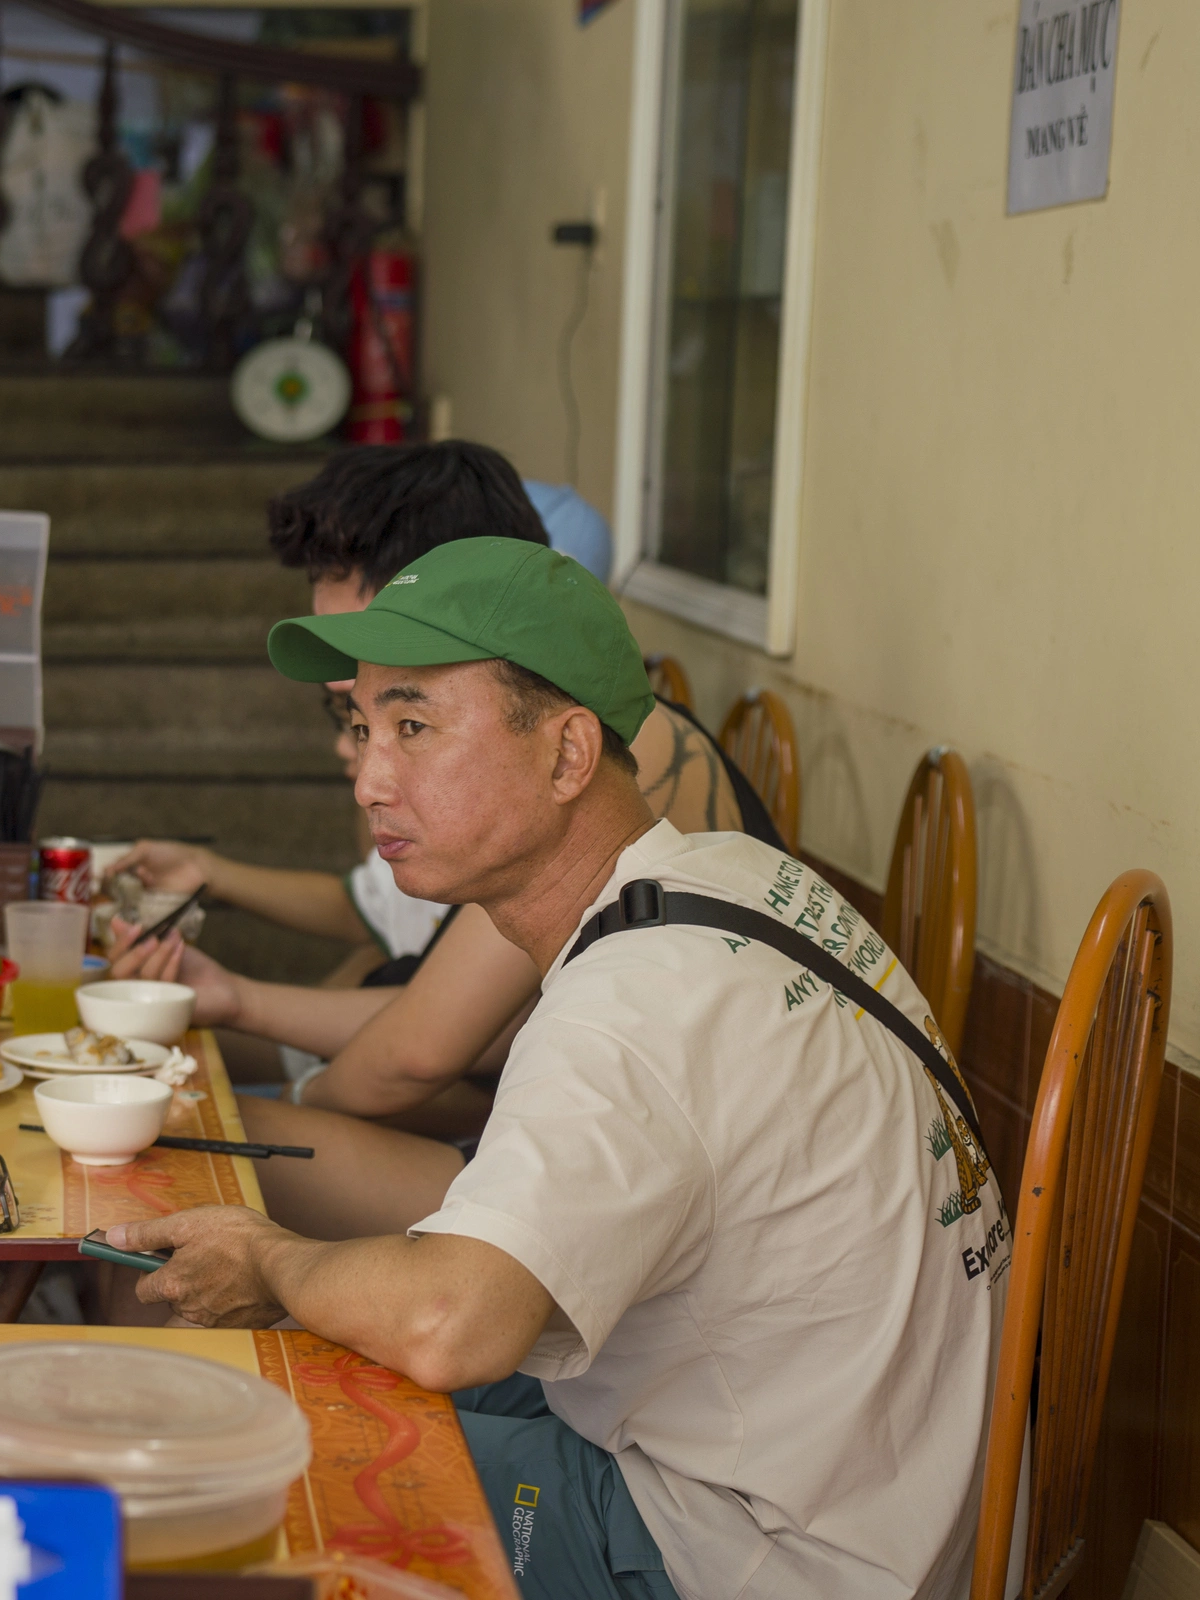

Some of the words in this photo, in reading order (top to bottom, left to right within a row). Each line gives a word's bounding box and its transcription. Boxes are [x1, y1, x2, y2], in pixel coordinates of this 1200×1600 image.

[1025, 116, 1066, 159] MANG
[764, 869, 800, 916] HOME
[850, 931, 886, 975] WORLD
[784, 969, 819, 1011] ANY
[512, 1507, 525, 1576] GEOGRAPHIC
[521, 1509, 535, 1563] NATIONAL
